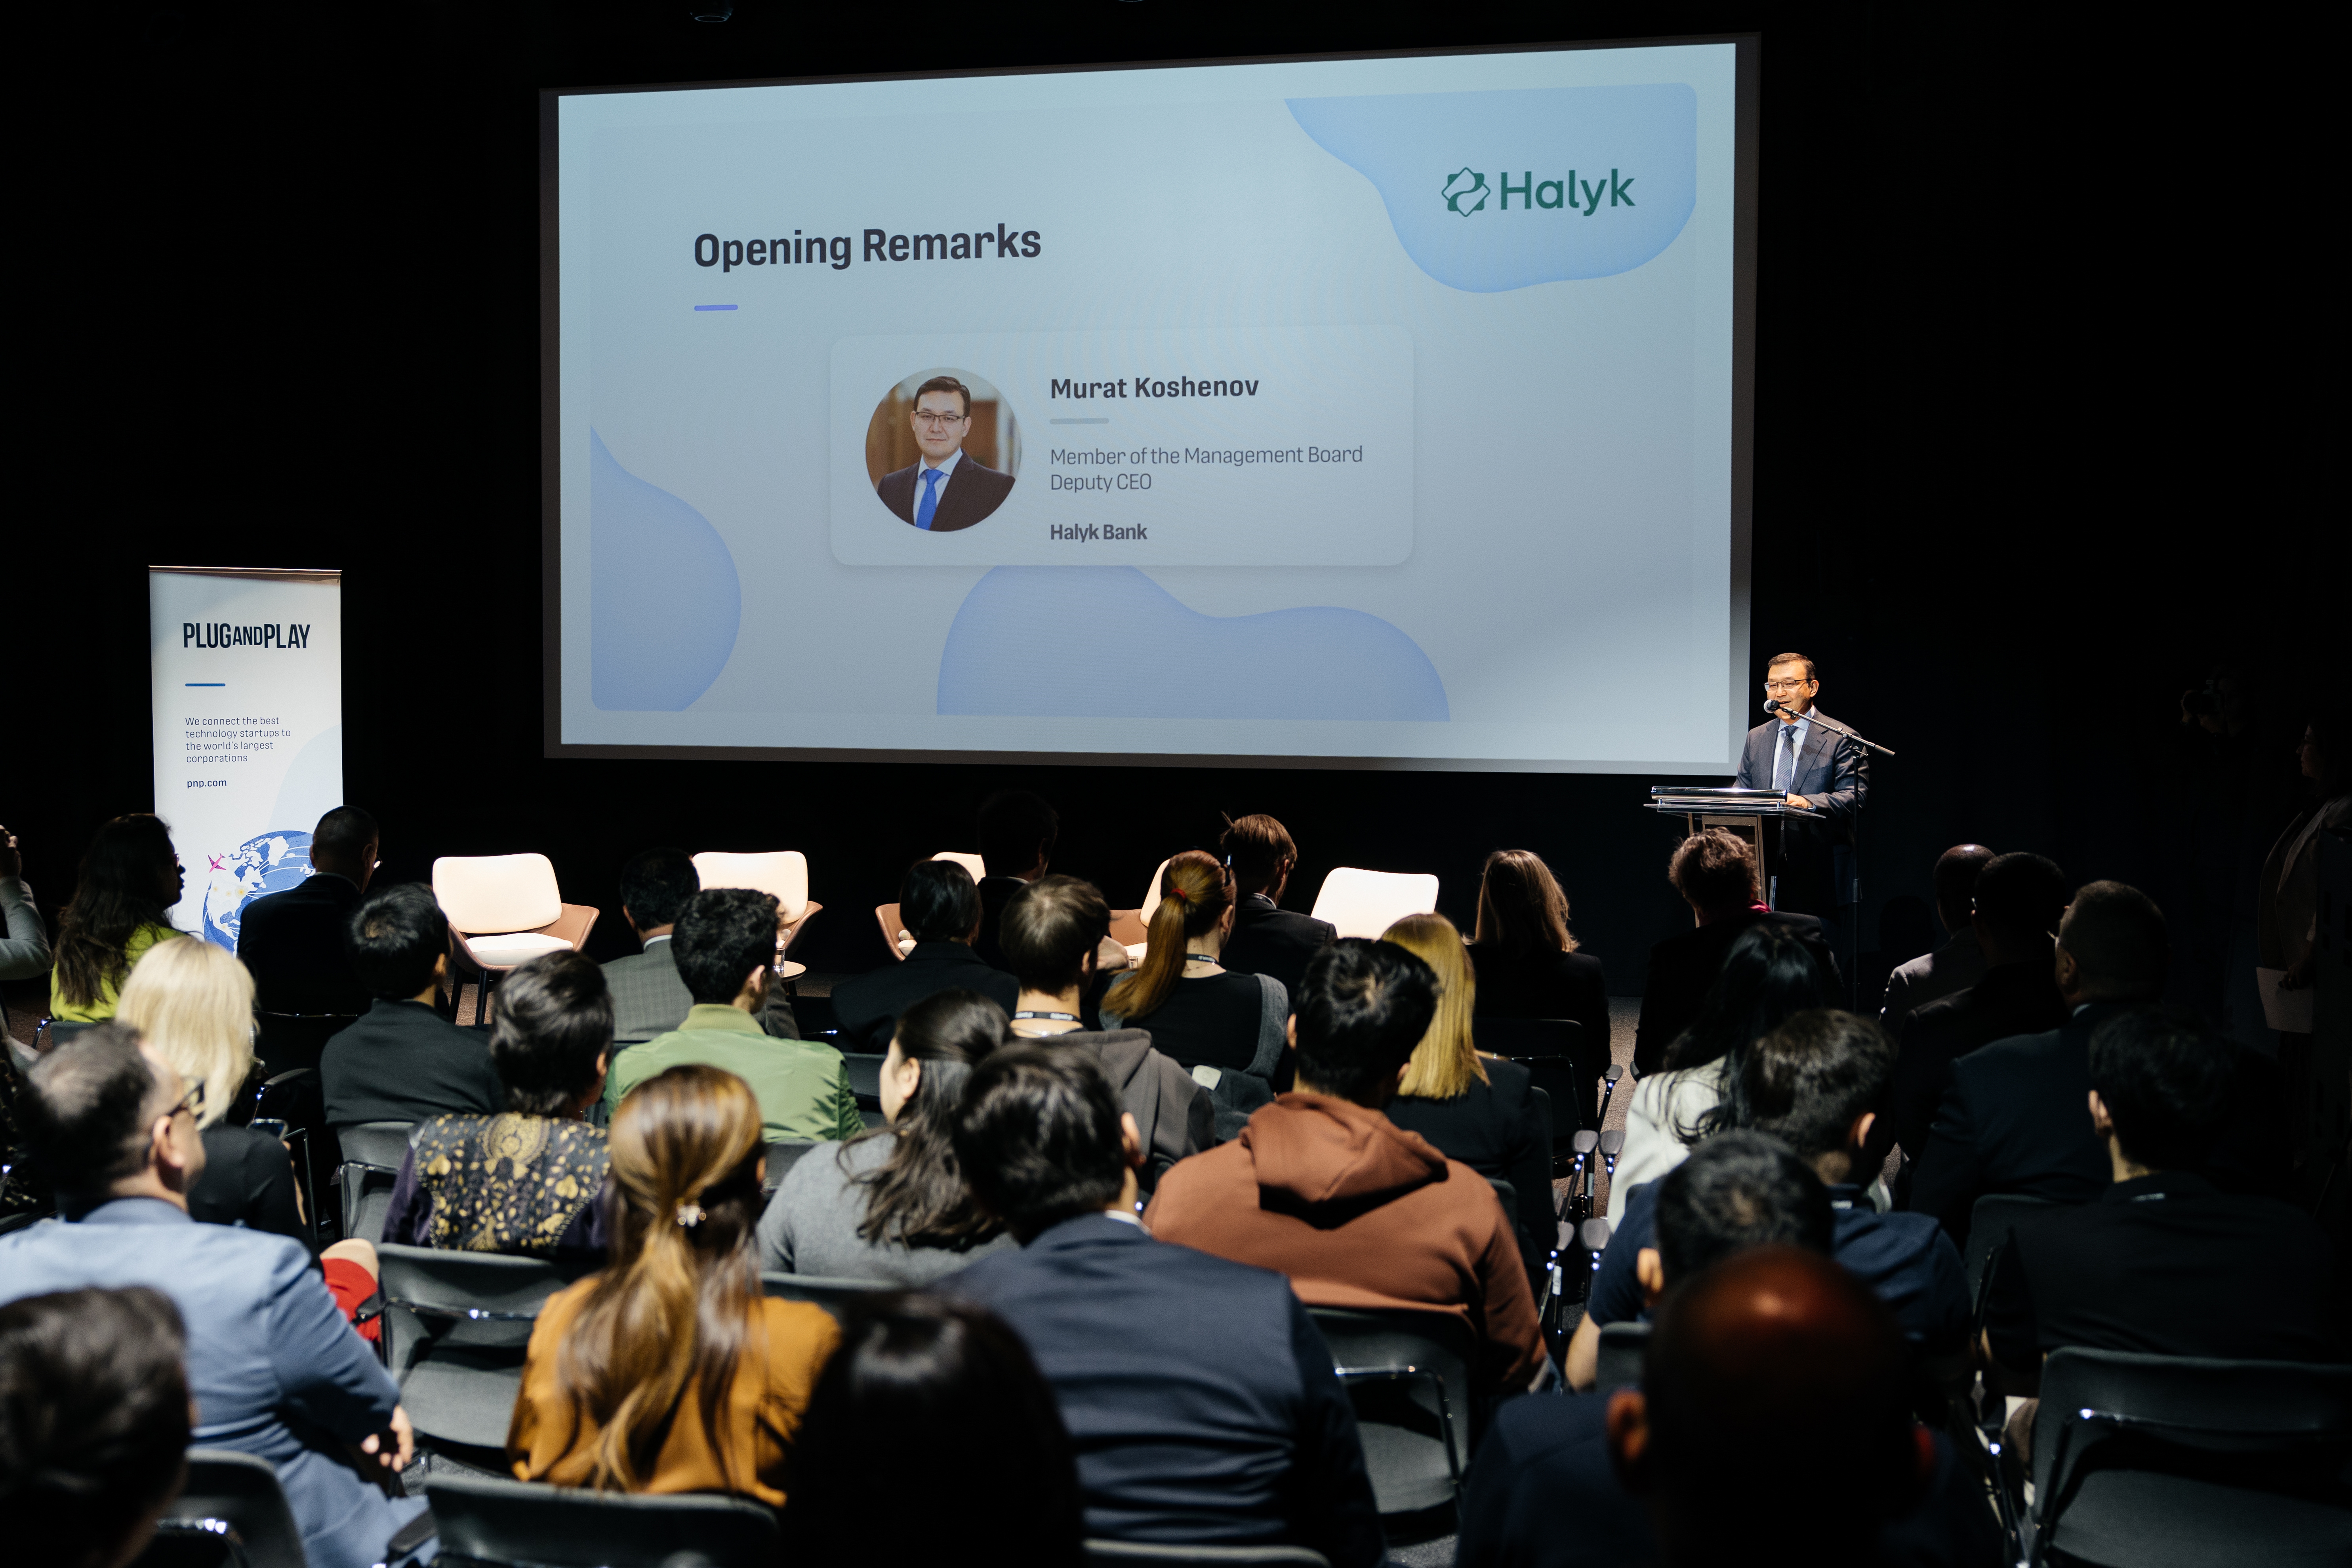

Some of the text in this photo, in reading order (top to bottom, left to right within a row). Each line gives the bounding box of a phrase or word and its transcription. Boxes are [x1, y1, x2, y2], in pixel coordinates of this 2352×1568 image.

[1501, 168, 1635, 217] Halyk
[694, 223, 1041, 273] Opening Remarks
[1051, 375, 1259, 399] Murat Koshenov
[1051, 445, 1363, 467] Member of the Management Board
[1051, 473, 1151, 493] Deputy CEO
[1051, 523, 1147, 543] Halyk Bank
[185, 716, 279, 726] We connect the best
[185, 729, 238, 739] technology
[240, 730, 279, 738] startups
[186, 741, 273, 751] the world's largest
[186, 754, 248, 764] corporations
[187, 780, 227, 789] pnp.com
